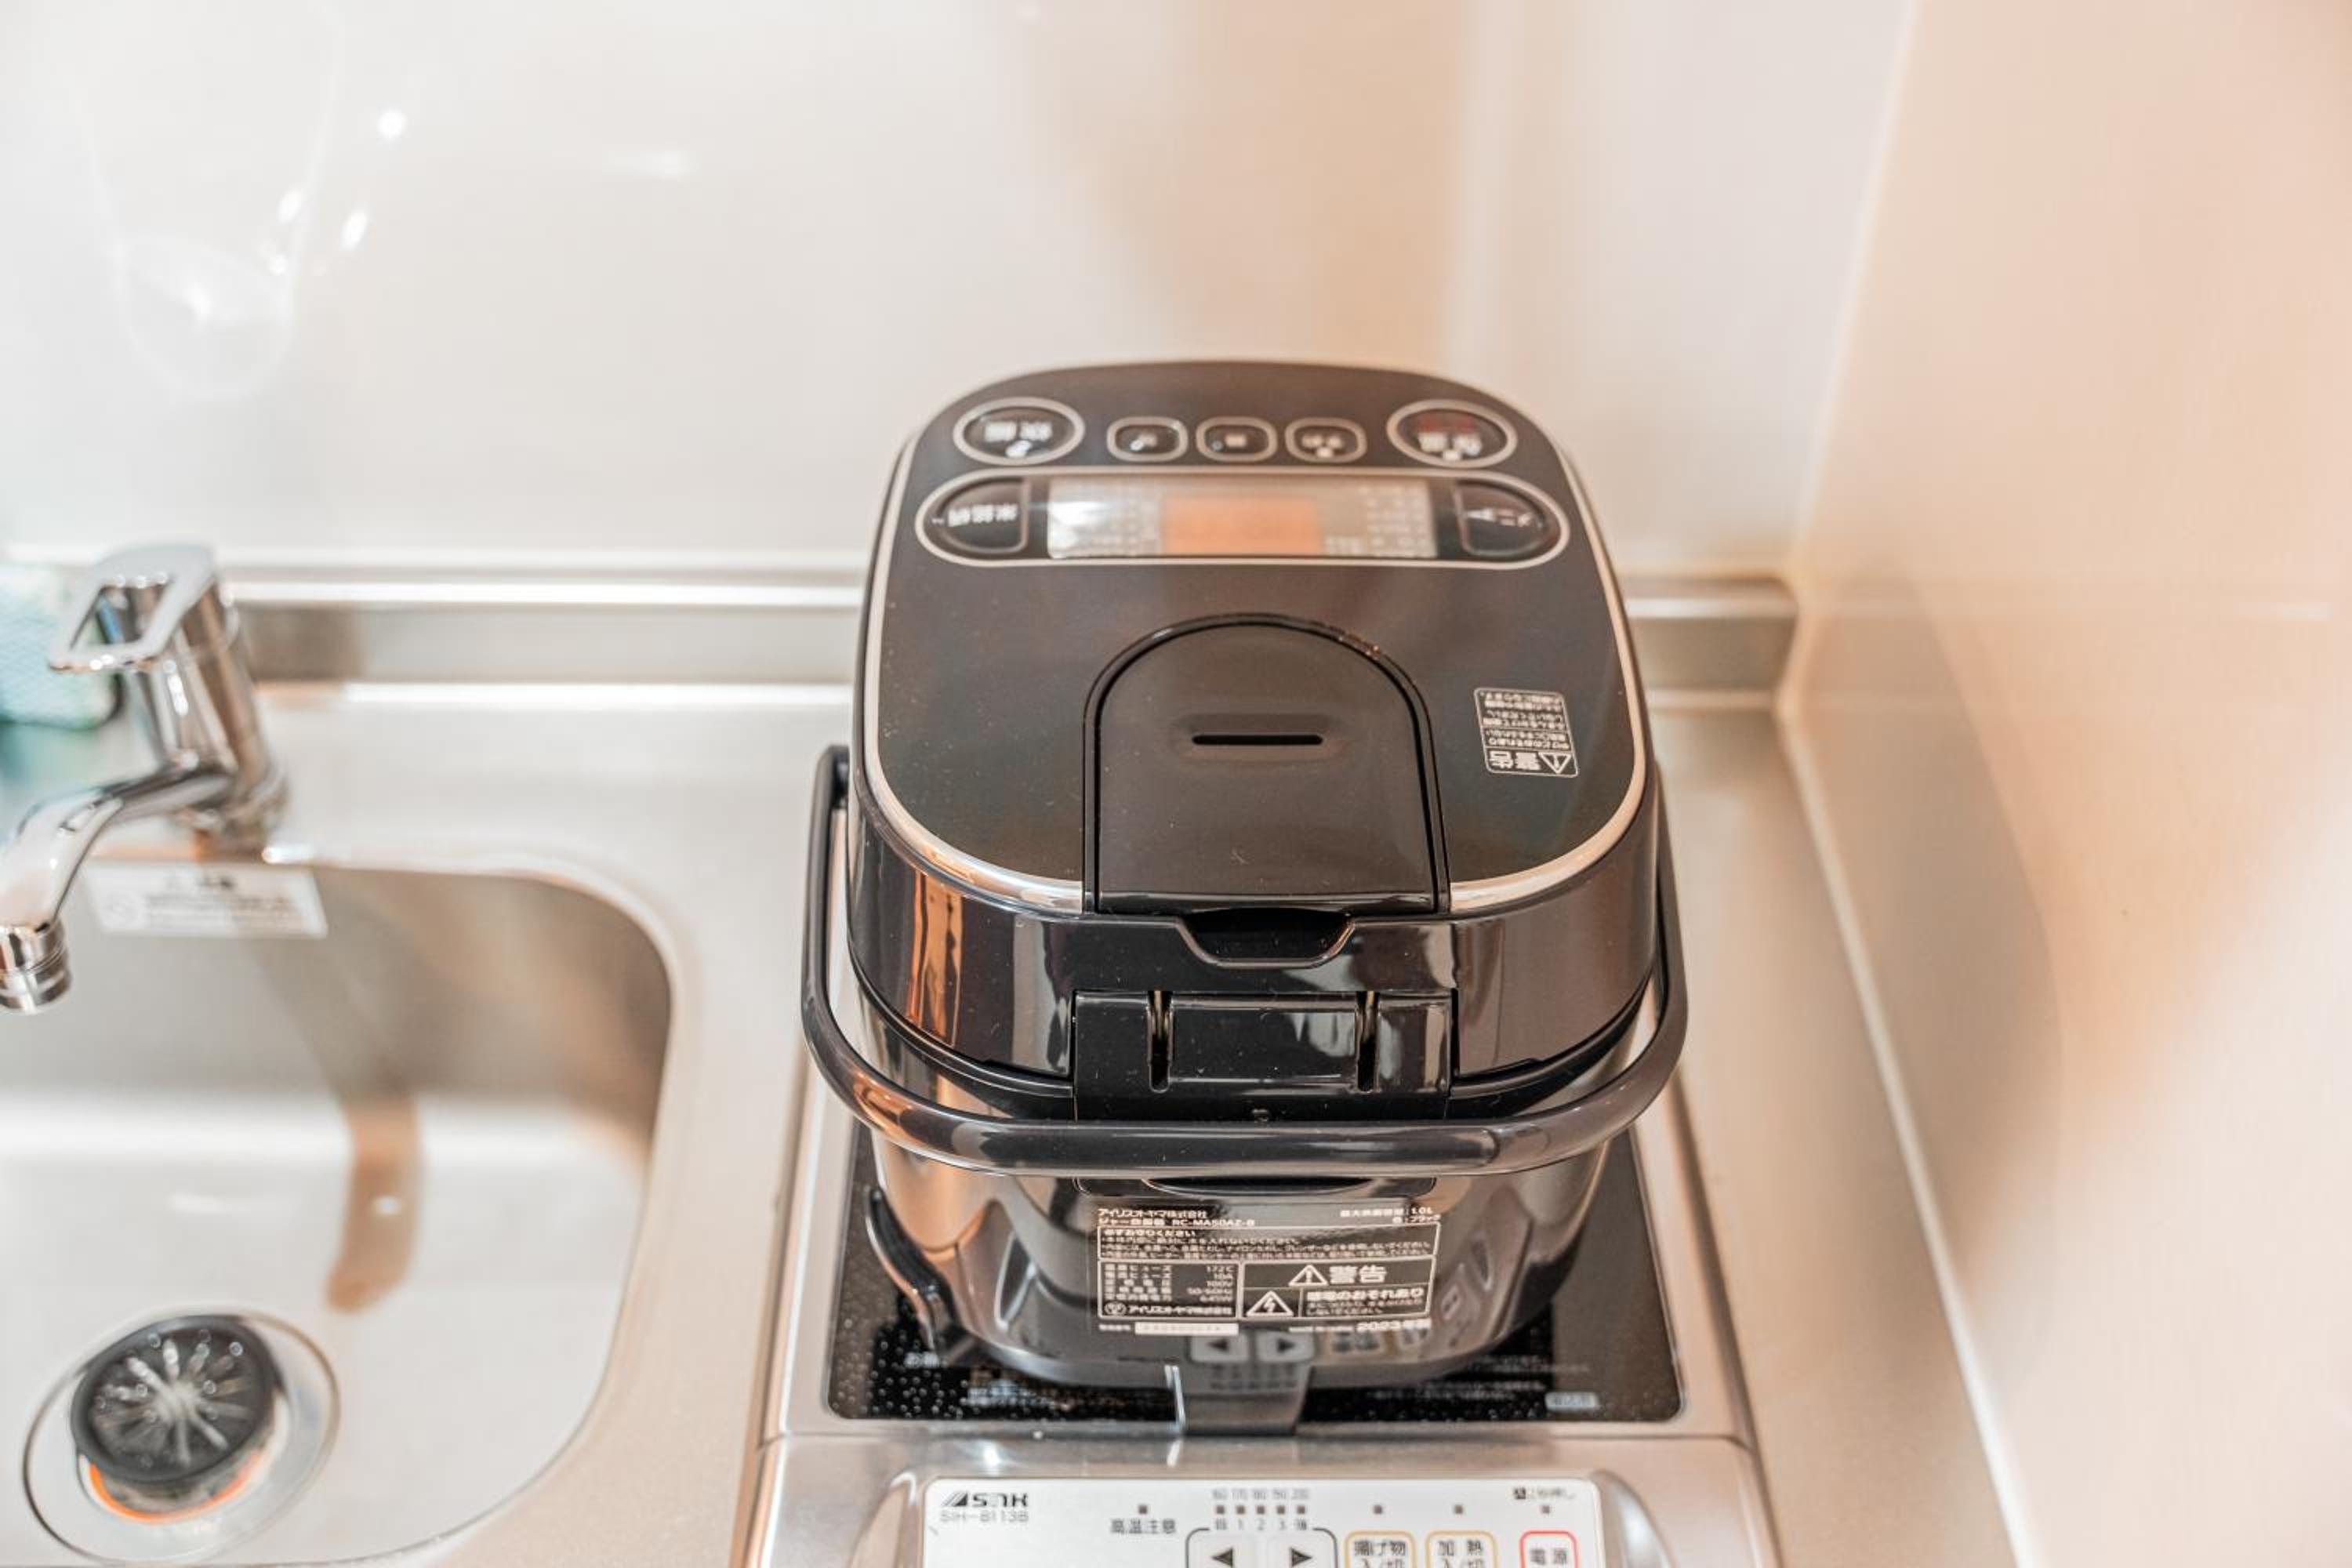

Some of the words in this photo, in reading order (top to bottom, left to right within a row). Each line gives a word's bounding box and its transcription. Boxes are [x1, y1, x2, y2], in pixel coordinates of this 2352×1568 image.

[1489, 750, 1541, 771] 警告
[1329, 1265, 1387, 1284] 警告
[1354, 1540, 1406, 1556] 揚げ物
[1530, 1548, 1568, 1565] 電源
